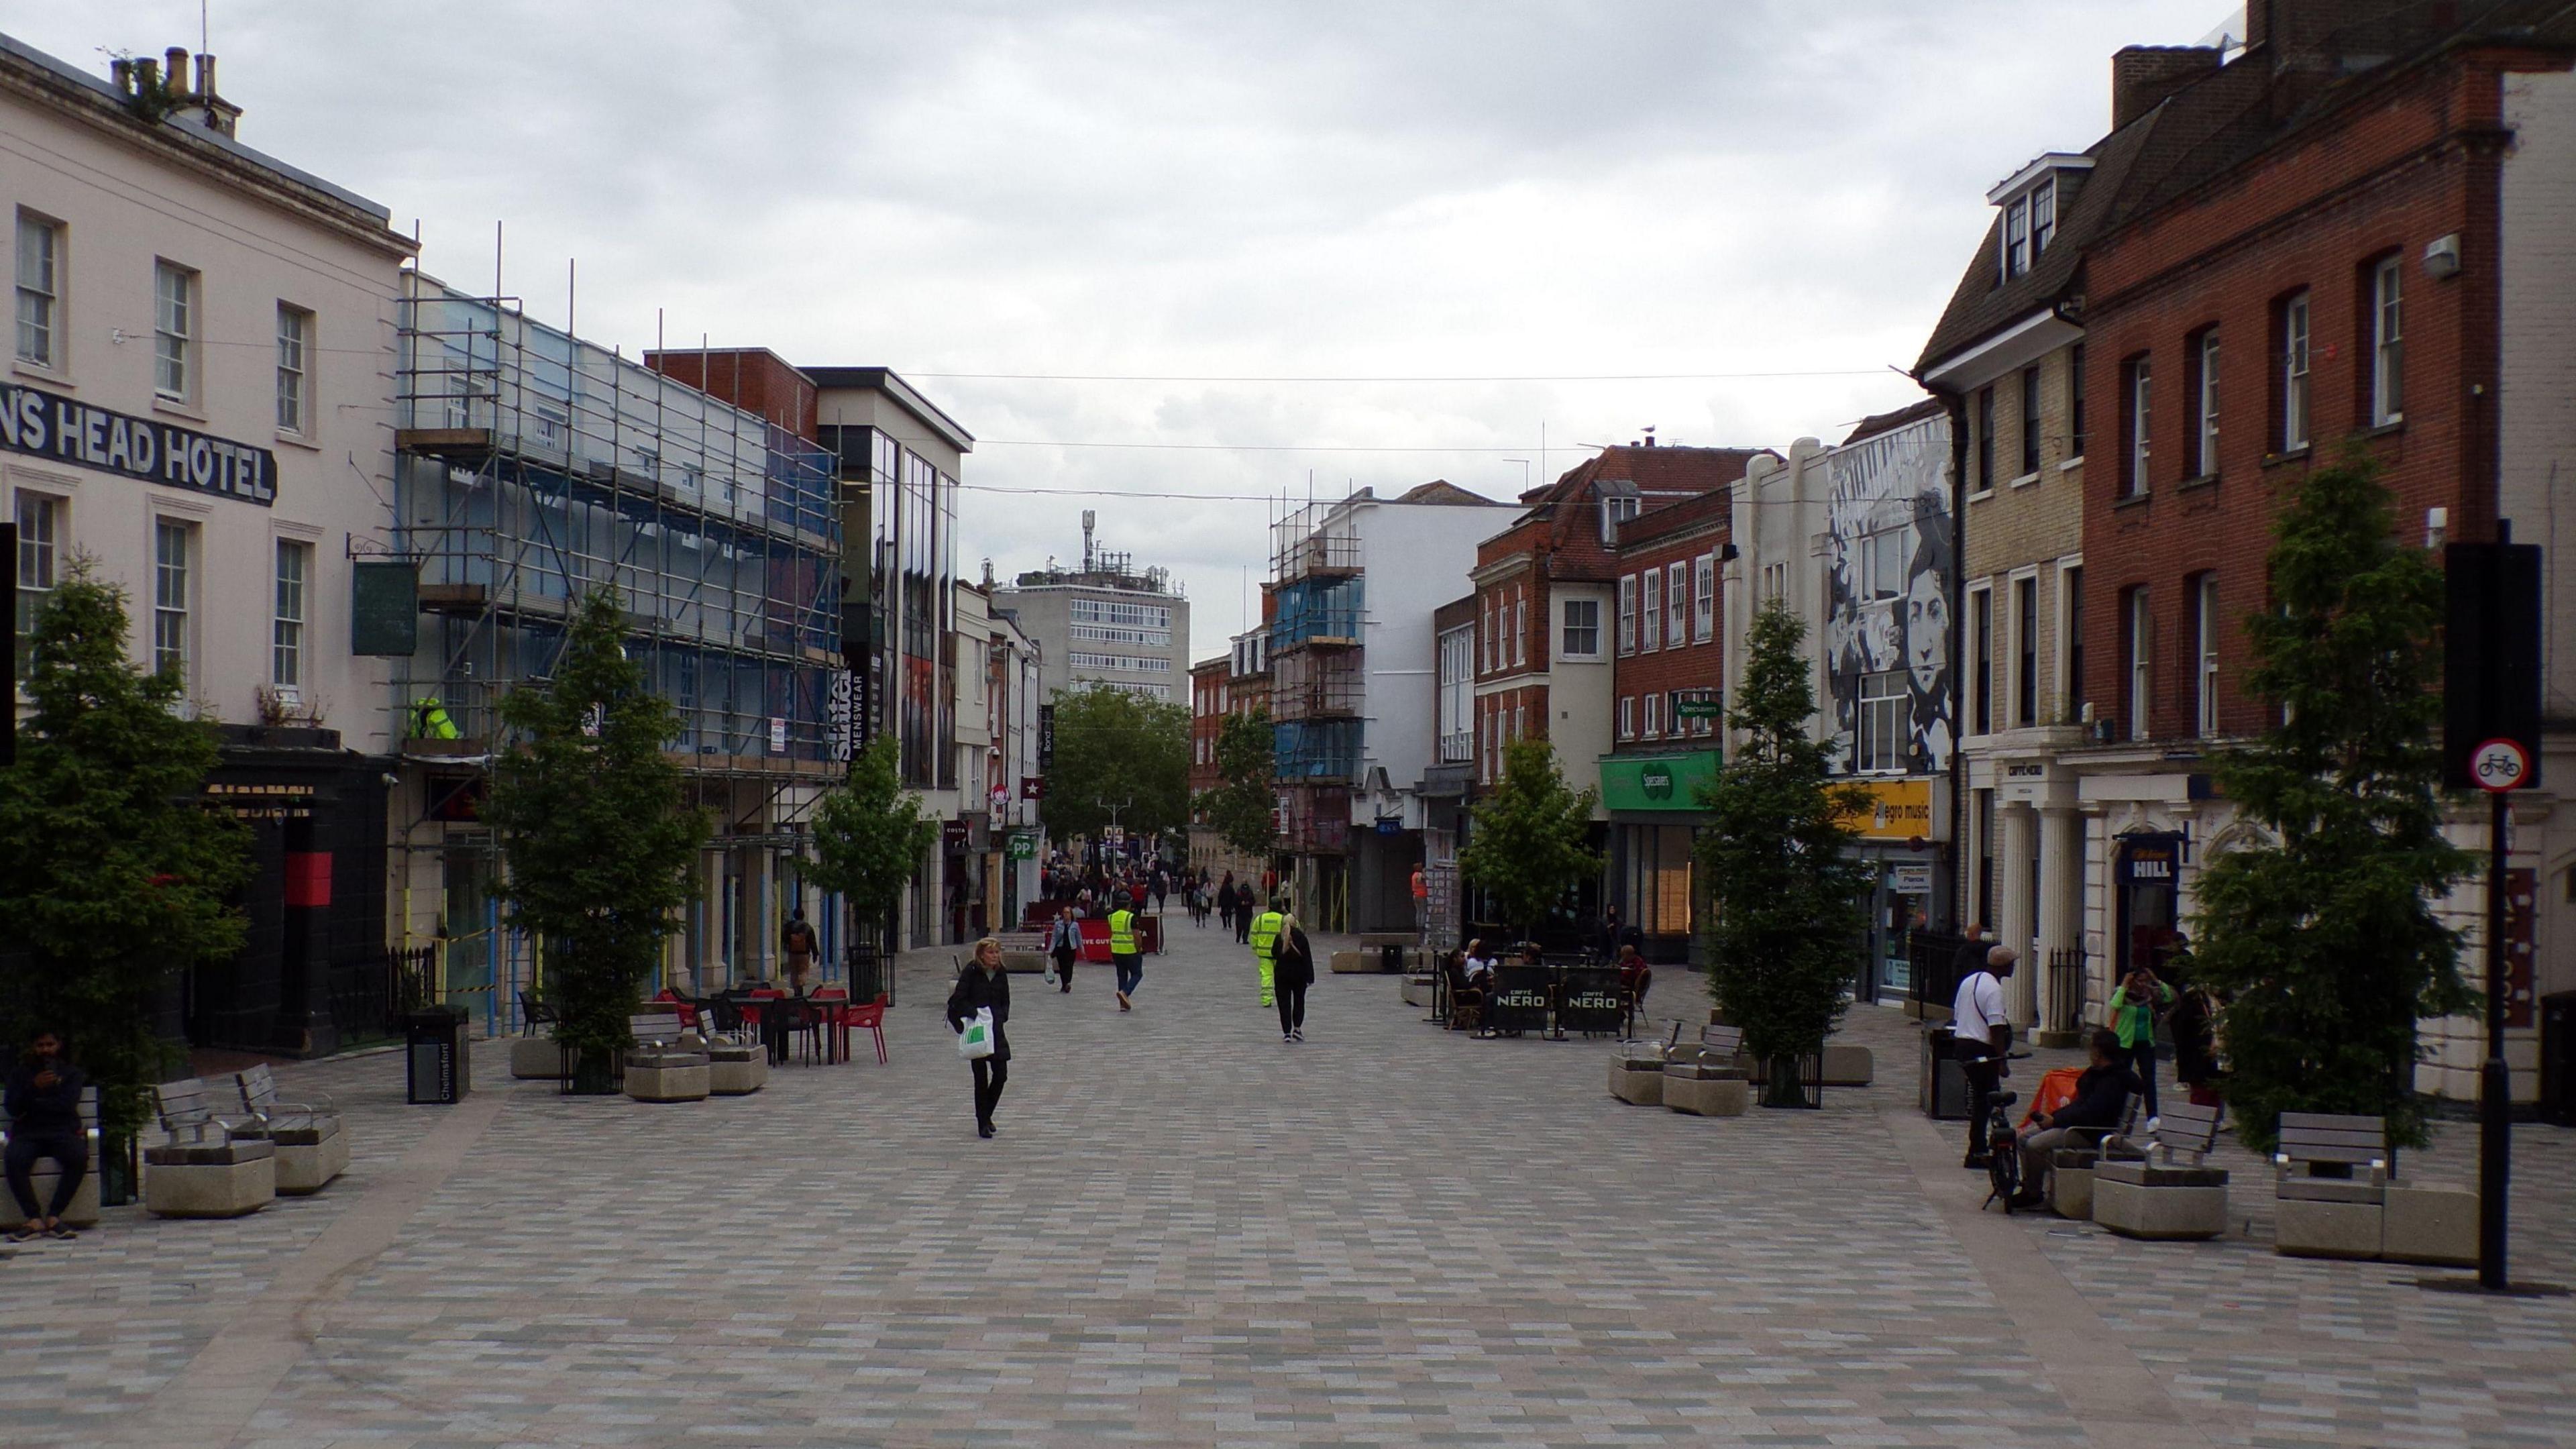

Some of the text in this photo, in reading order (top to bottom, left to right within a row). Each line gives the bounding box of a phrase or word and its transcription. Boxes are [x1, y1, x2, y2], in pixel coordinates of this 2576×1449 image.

[55, 400, 156, 475] HEAD
[164, 429, 272, 501] HOTEL
[853, 676, 863, 750] MENSWEAR
[1680, 705, 1717, 714] Specsavers
[1044, 731, 1052, 752] Bond
[1644, 773, 1670, 790] Specsavers
[1875, 801, 1903, 824] Allegro
[1904, 800, 1929, 820] music
[1014, 843, 1031, 855] PP
[2133, 861, 2171, 877] HILL
[1497, 996, 1545, 1007] NERO
[1568, 997, 1617, 1009] NERO
[441, 1043, 450, 1101] Chelmsford
